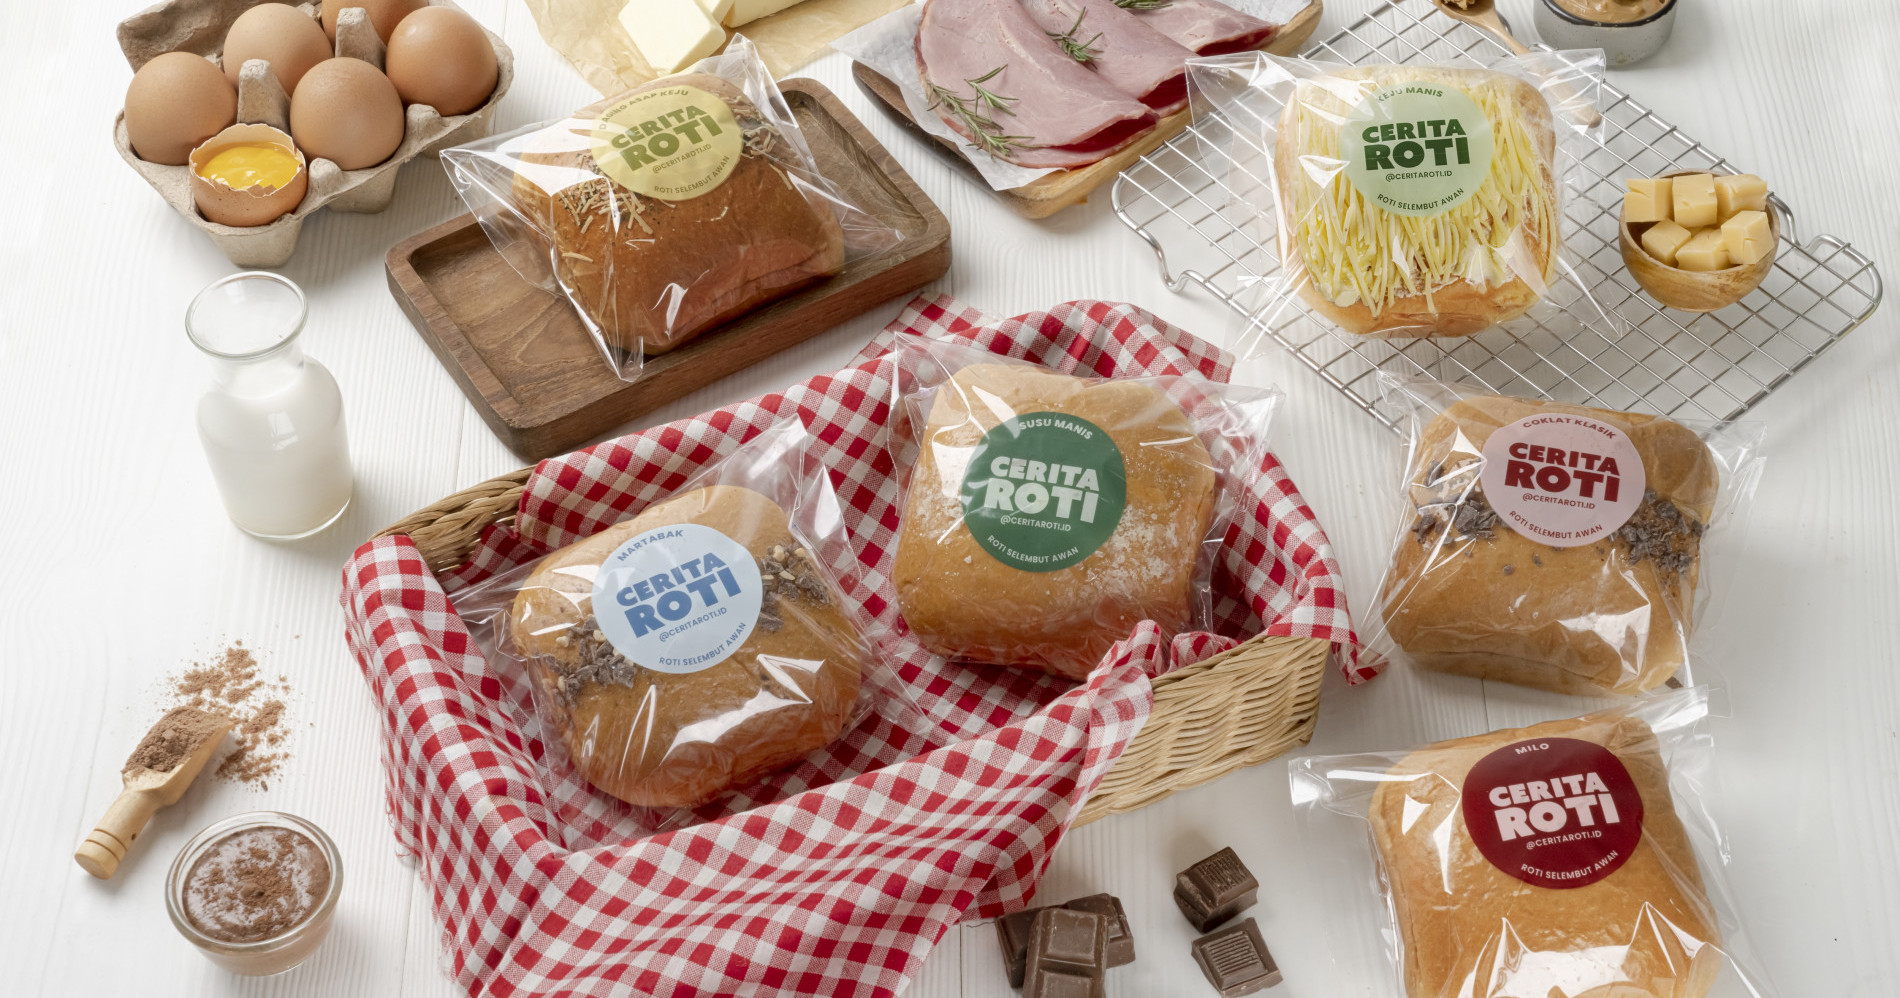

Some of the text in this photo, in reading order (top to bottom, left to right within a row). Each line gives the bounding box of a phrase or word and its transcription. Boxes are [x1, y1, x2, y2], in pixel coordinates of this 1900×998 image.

[629, 93, 657, 105] ASAP
[1378, 87, 1443, 102] KEJU MANIS
[612, 105, 707, 148] CERITA
[1362, 119, 1466, 143] CERITA
[620, 115, 723, 171] ROTI
[1364, 137, 1470, 170] ROTI
[652, 144, 712, 174] @CERITAROTI.ID
[675, 176, 712, 193] SELEMBUT
[712, 156, 729, 178] AWAN
[1386, 171, 1452, 182] @CERITAROTI.ID
[1378, 188, 1464, 210] ROTI SELEMBUT AWAN
[1019, 418, 1092, 439] SUSU MANIS
[1523, 418, 1616, 439] COKLAT KLASIK
[991, 456, 1099, 491] CERITA
[1509, 442, 1620, 476] CERITA
[1505, 460, 1620, 502] ROTI
[984, 478, 1099, 523] ROTI
[1523, 493, 1595, 510] @CERITAROTI.ID
[1000, 515, 1071, 532] @CERITAROTI.ID
[1509, 510, 1602, 539] ROTI SELEMBUT AWAN
[617, 530, 683, 561] MARTABAK
[987, 535, 1079, 563] ROTI SELEMBUT AWAN
[616, 552, 726, 606] CERITA
[624, 567, 741, 638] ROTI
[659, 607, 727, 642] @CERITAROTI.ID
[659, 622, 746, 666] ROTI SELEMBUT AWAN
[1515, 743, 1549, 755] MILO
[1489, 772, 1609, 807] CERITA
[1494, 793, 1620, 842] ROTI
[1526, 830, 1602, 849] @CERITAROTI.ID
[1521, 850, 1619, 880] ROTI SELEMBUT AWAN
